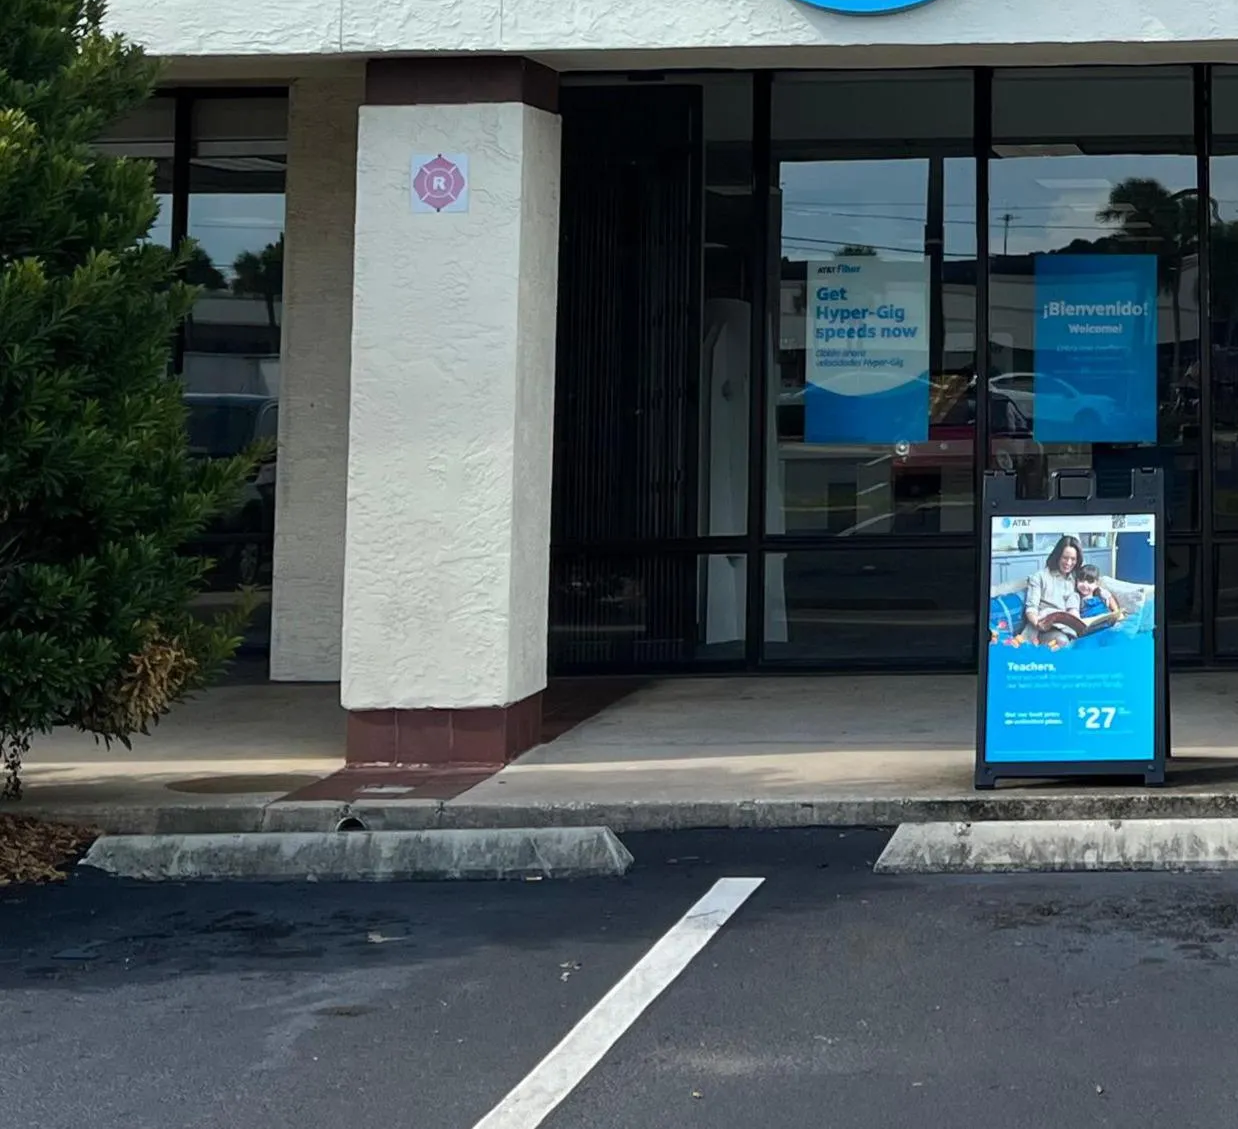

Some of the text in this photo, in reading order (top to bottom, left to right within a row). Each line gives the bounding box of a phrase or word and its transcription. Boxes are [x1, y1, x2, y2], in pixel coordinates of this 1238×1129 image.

[433, 176, 446, 191] R
[816, 287, 847, 301] Get
[816, 304, 905, 323] Hyper-Gig
[1043, 301, 1148, 319] ¡Bienvenido!
[816, 324, 917, 342] speeds now
[1068, 323, 1123, 334] Welcome!
[1012, 518, 1031, 527] AT&T
[1007, 661, 1056, 672] Teachers.
[1078, 706, 1117, 729] $27
